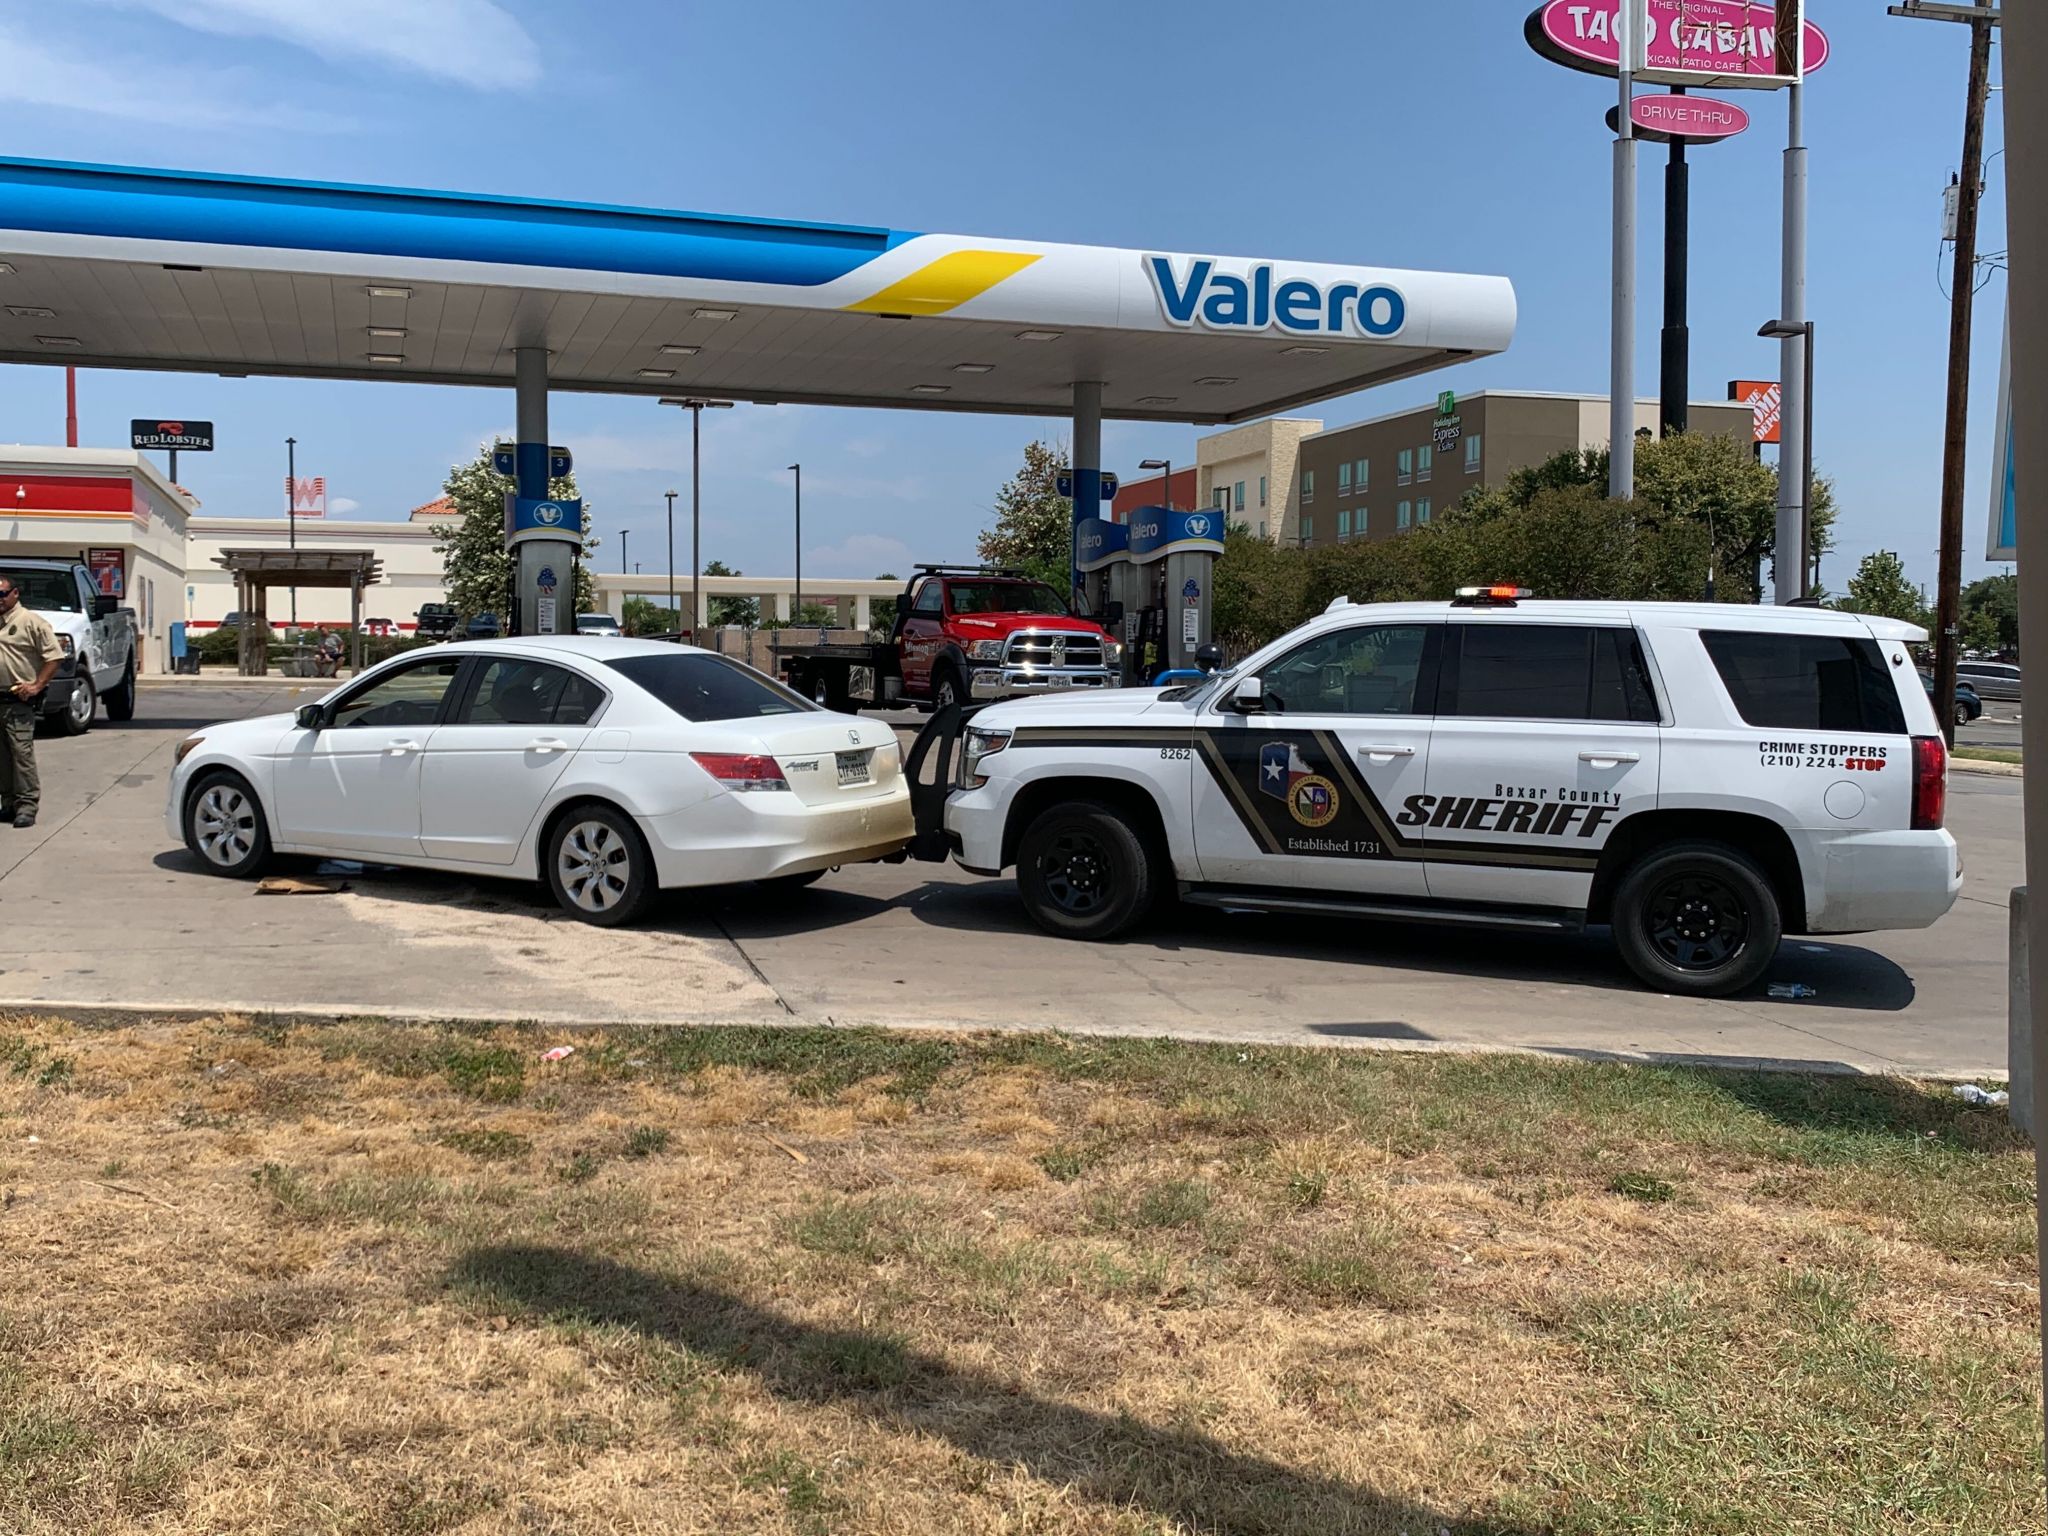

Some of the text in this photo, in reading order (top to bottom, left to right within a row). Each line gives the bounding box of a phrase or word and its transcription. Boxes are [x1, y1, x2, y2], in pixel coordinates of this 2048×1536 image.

[1653, 0, 1673, 10] THE
[1669, 16, 1775, 58] CABAN
[1648, 54, 1743, 72] XICAN PATIO CAFE
[1641, 105, 1733, 125] DRIVE THRU
[1150, 256, 1405, 336] Valero
[134, 434, 160, 445] RED
[160, 432, 212, 448] LOBSTER
[1432, 426, 1460, 443] Express
[500, 455, 508, 464] 4
[556, 458, 564, 467] 3
[1061, 478, 1068, 487] 2
[1106, 482, 1111, 490] 1
[904, 640, 929, 656] Mission
[1160, 749, 1191, 760] 8262
[1759, 741, 1887, 758] CRIME STOPPERS
[1760, 754, 1886, 771] (210) 224-STOP
[1495, 783, 1621, 806] Bexar County
[1395, 794, 1620, 838] SHERIFF
[1288, 838, 1380, 854] Established 1731
